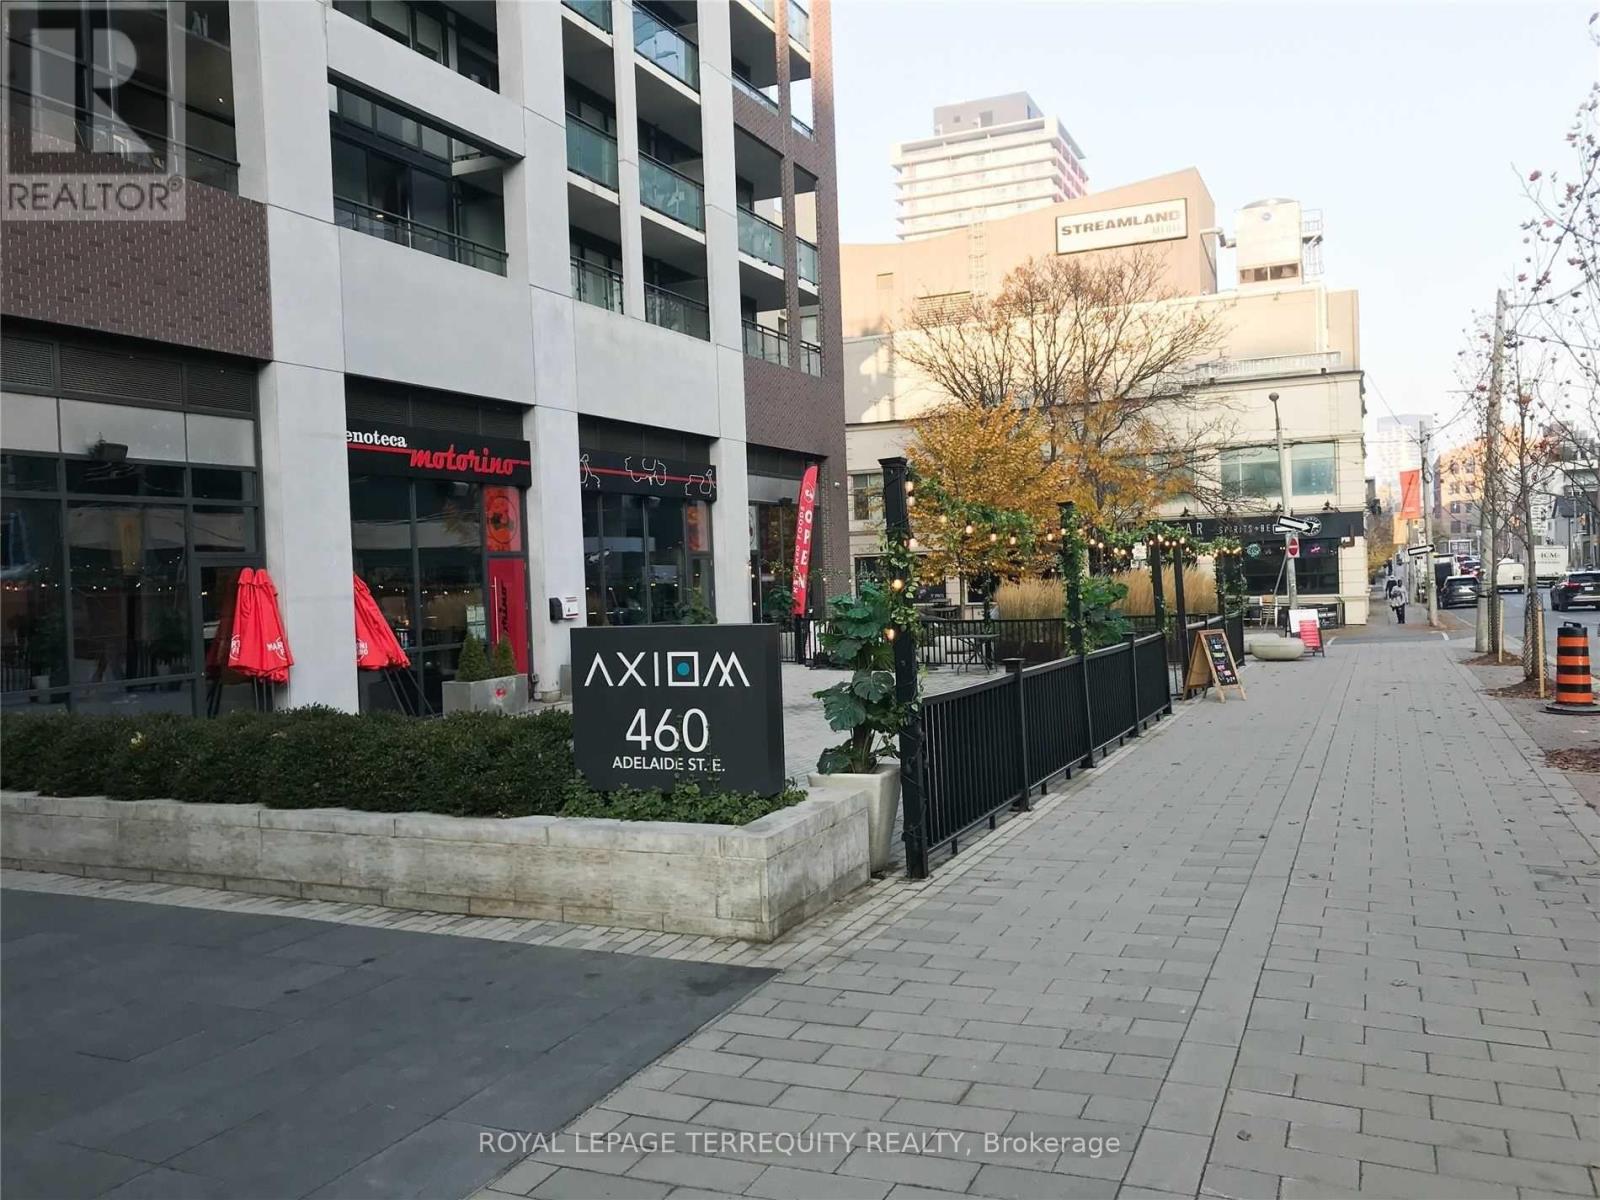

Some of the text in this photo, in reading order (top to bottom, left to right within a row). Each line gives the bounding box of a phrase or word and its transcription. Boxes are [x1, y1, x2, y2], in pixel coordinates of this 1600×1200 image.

[1062, 210, 1180, 235] STREAMLAND
[346, 430, 407, 448] enoteca
[410, 444, 514, 475] motorino
[799, 510, 812, 588] OPEN
[584, 651, 750, 687] AXIOM
[625, 708, 709, 753] 460
[612, 756, 725, 772] ADELAIDE ST. E.
